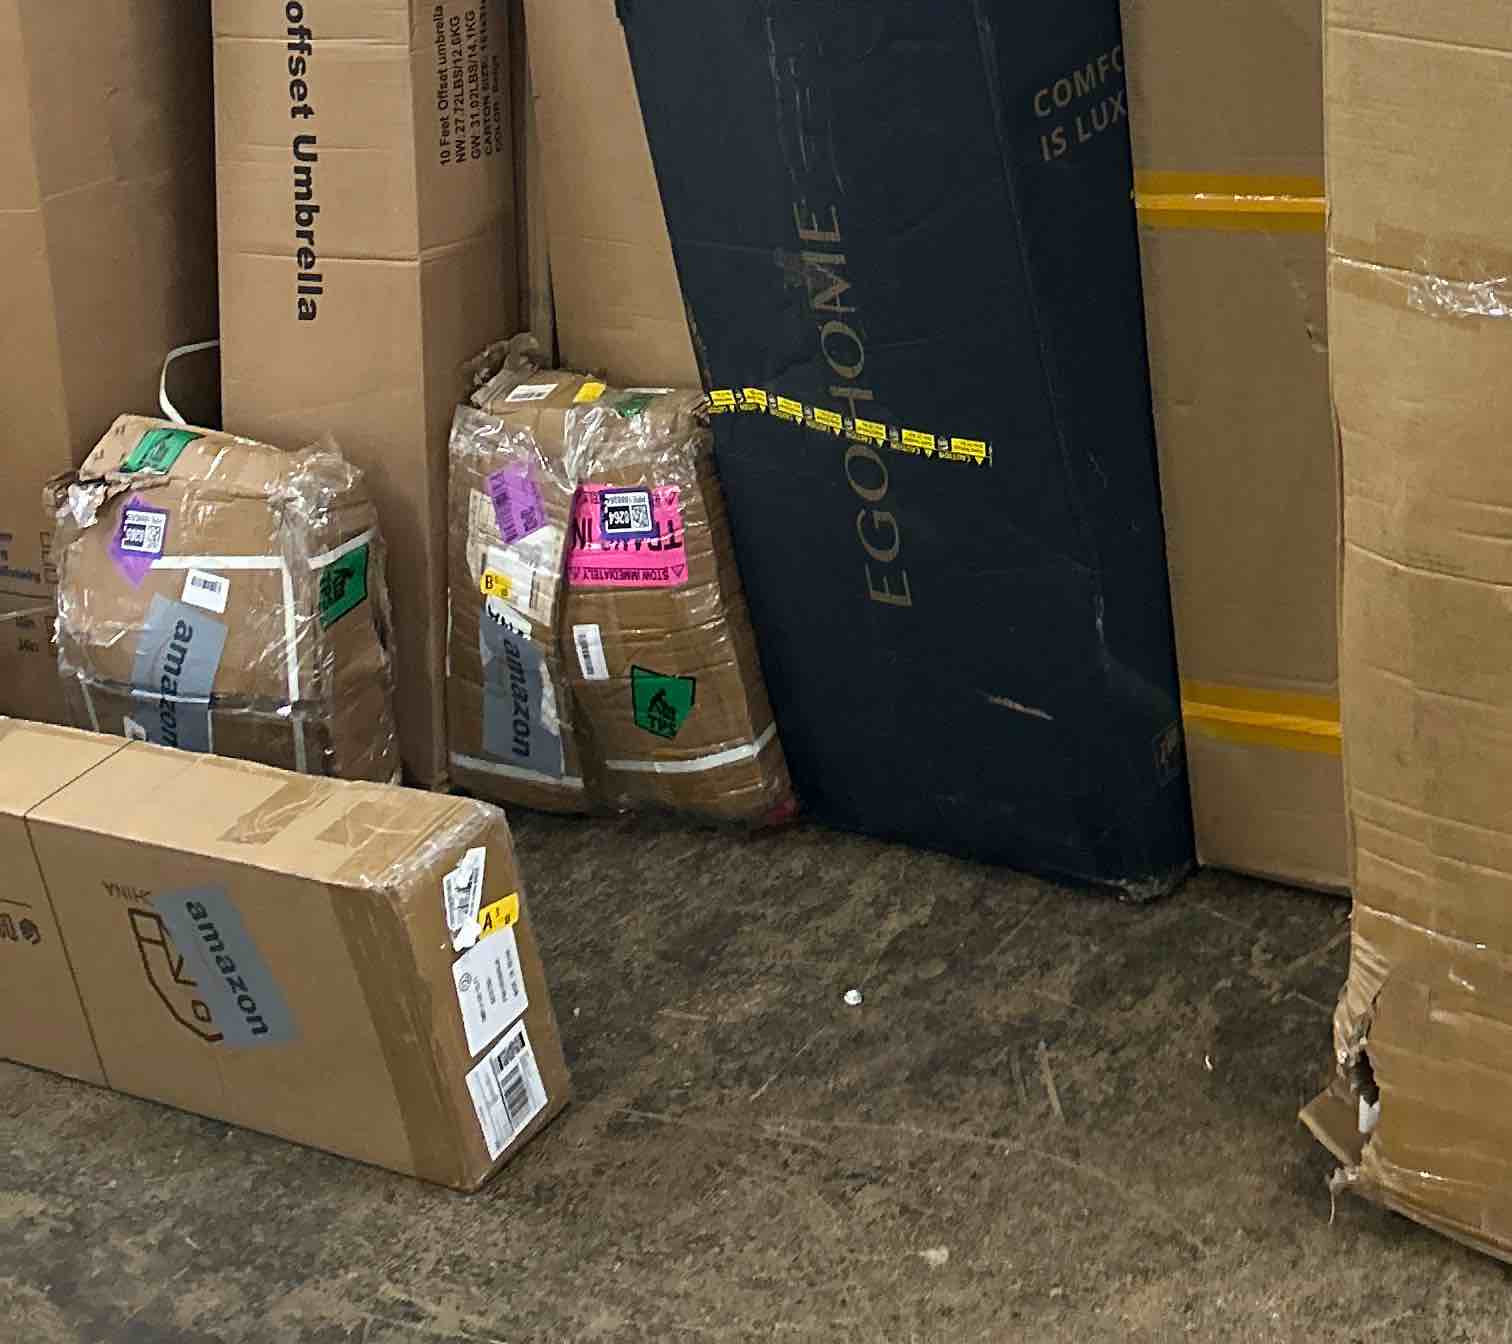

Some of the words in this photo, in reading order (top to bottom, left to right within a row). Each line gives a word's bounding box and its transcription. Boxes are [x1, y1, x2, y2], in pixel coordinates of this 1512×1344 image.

[284, 0, 315, 120] offset
[440, 151, 451, 166] 10
[1039, 125, 1068, 162] IS
[291, 135, 324, 323] Umbrella
[159, 618, 194, 747] amazon
[504, 638, 531, 757] amazon
[186, 899, 269, 1036] amazon
